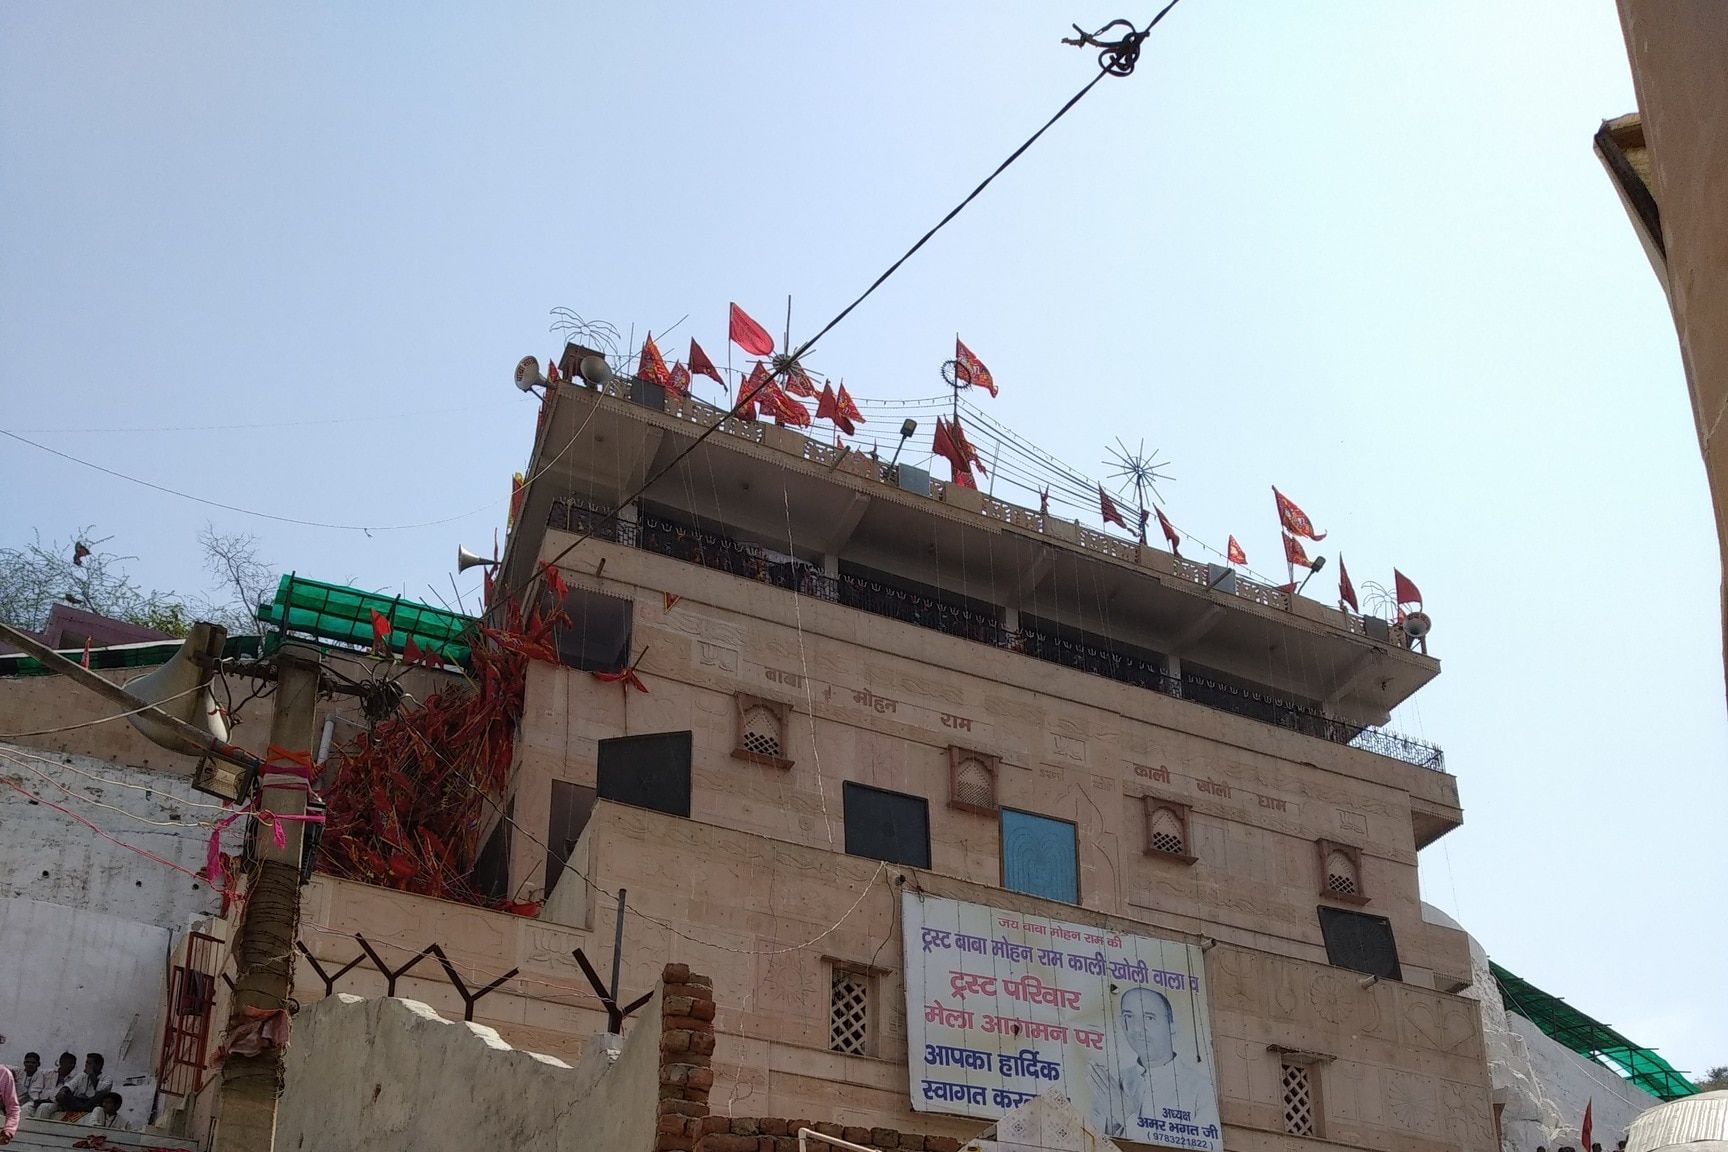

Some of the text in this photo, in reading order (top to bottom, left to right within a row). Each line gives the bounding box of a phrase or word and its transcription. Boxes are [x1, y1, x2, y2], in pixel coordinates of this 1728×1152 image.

[851, 687, 898, 714] मोहन
[940, 711, 974, 732] राम
[1133, 763, 1172, 784] काली
[1195, 776, 1232, 799] खोली
[998, 918, 1019, 930] जय
[1050, 925, 1081, 942] मोहन
[1084, 933, 1104, 945] राम
[1106, 936, 1122, 949] की
[921, 927, 1199, 992] ट्रस्ट बाबा मोहन राम काली खोली वाला व
[949, 971, 1081, 1010] ट्रस्ट परिवार
[924, 1000, 1104, 1050] मेला आगमन पर
[924, 1044, 1060, 1081] आपका हार्दिक
[921, 1079, 987, 1106] स्वागत
[1137, 1116, 1218, 1139] अमर भगत जी
[1162, 1107, 1191, 1121] अध्यक्ष
